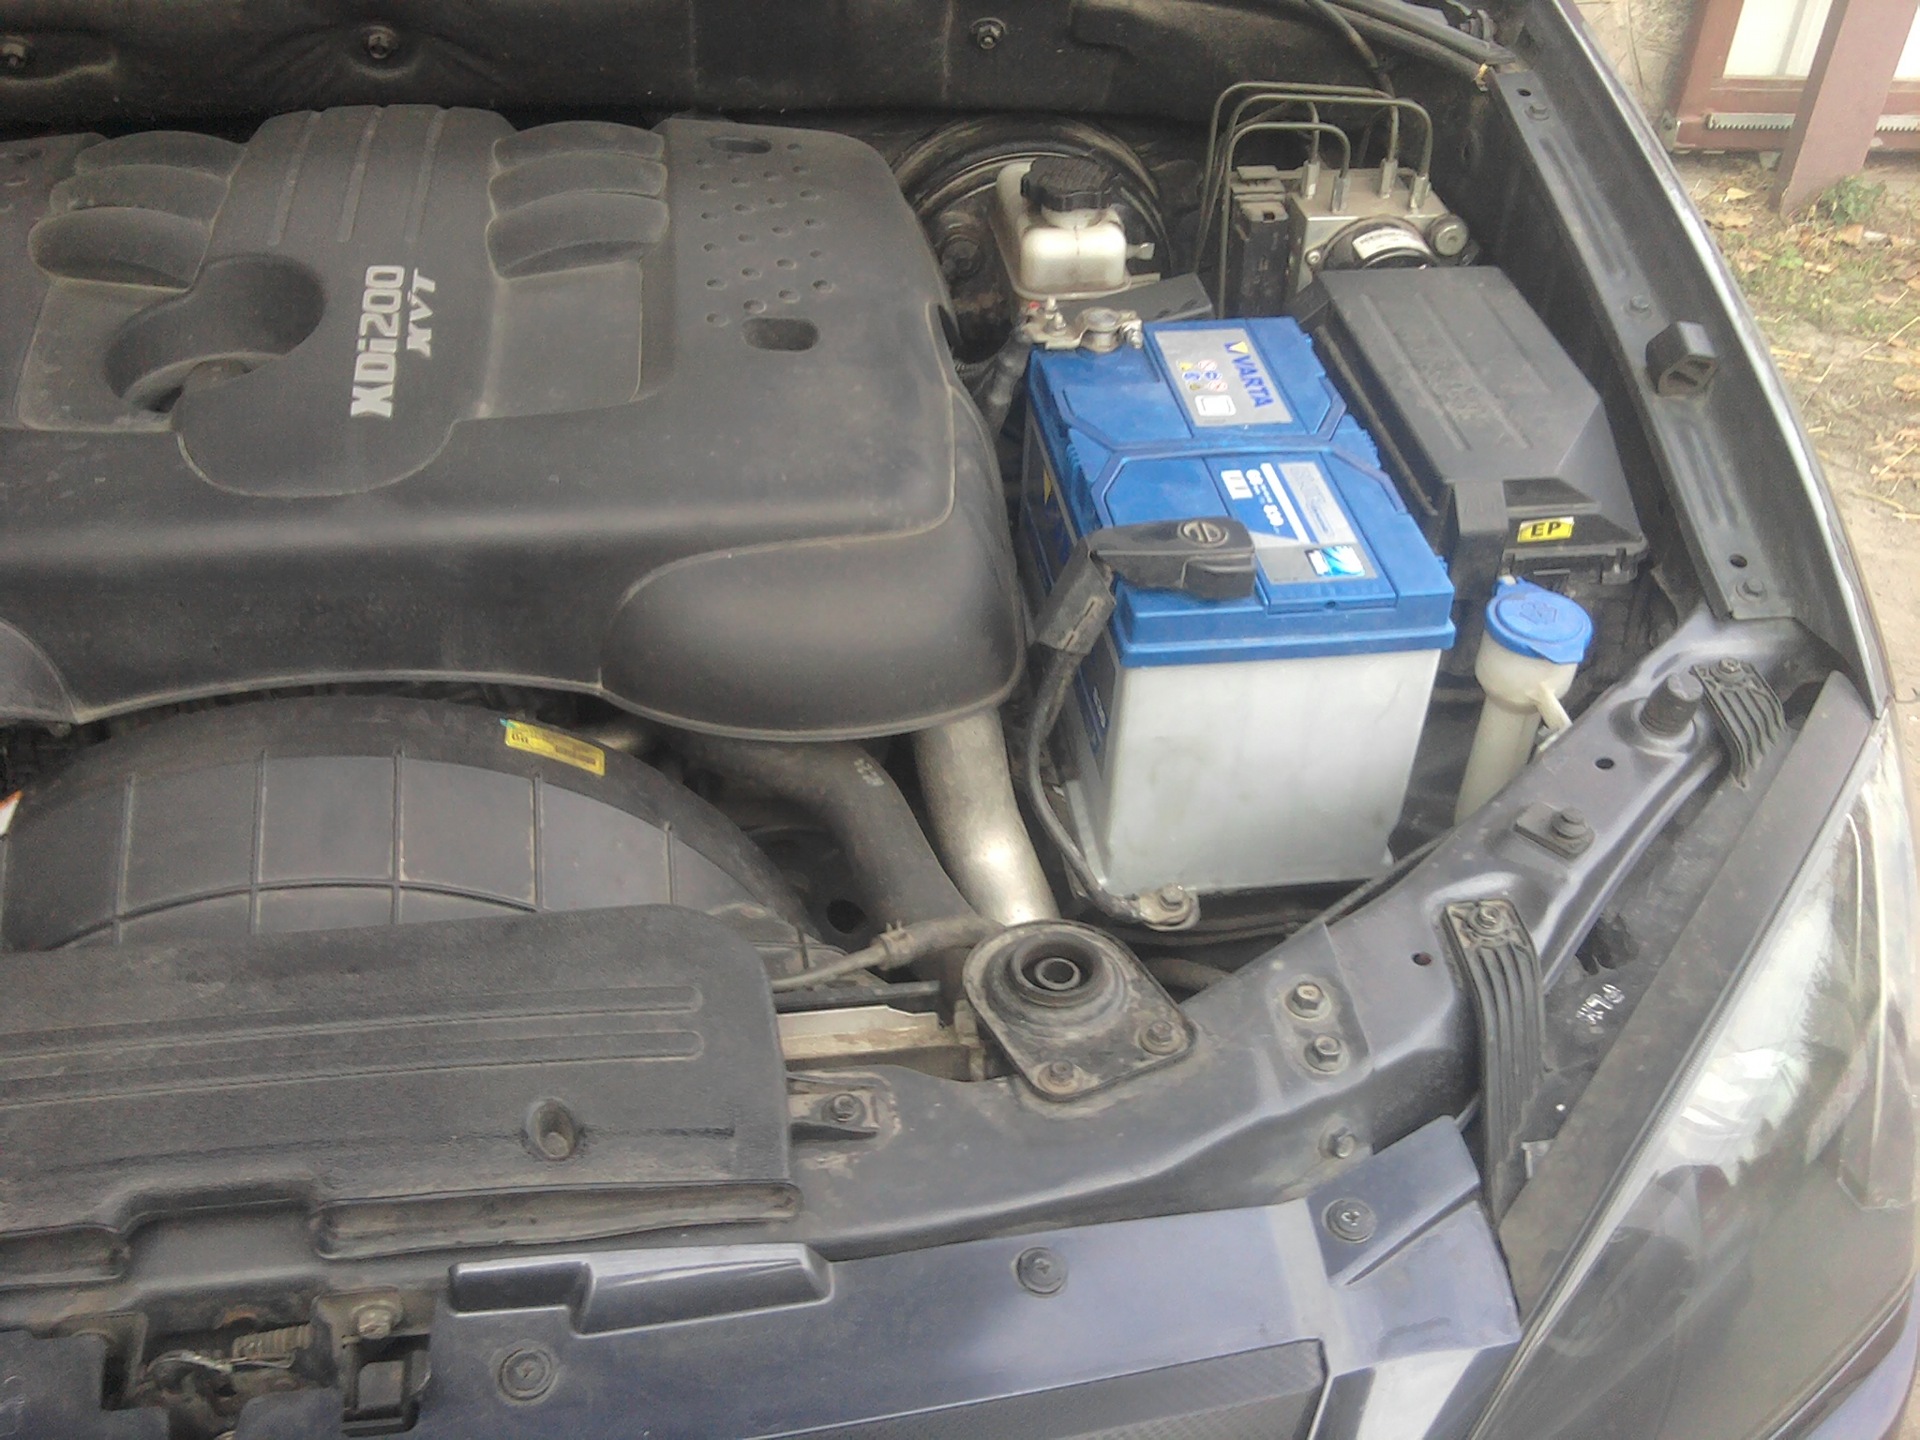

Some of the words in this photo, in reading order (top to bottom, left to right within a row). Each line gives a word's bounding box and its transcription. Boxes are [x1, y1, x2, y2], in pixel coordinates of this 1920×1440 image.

[350, 265, 405, 418] XDi200
[1232, 354, 1275, 408] VARTA
[1531, 521, 1562, 538] EP
